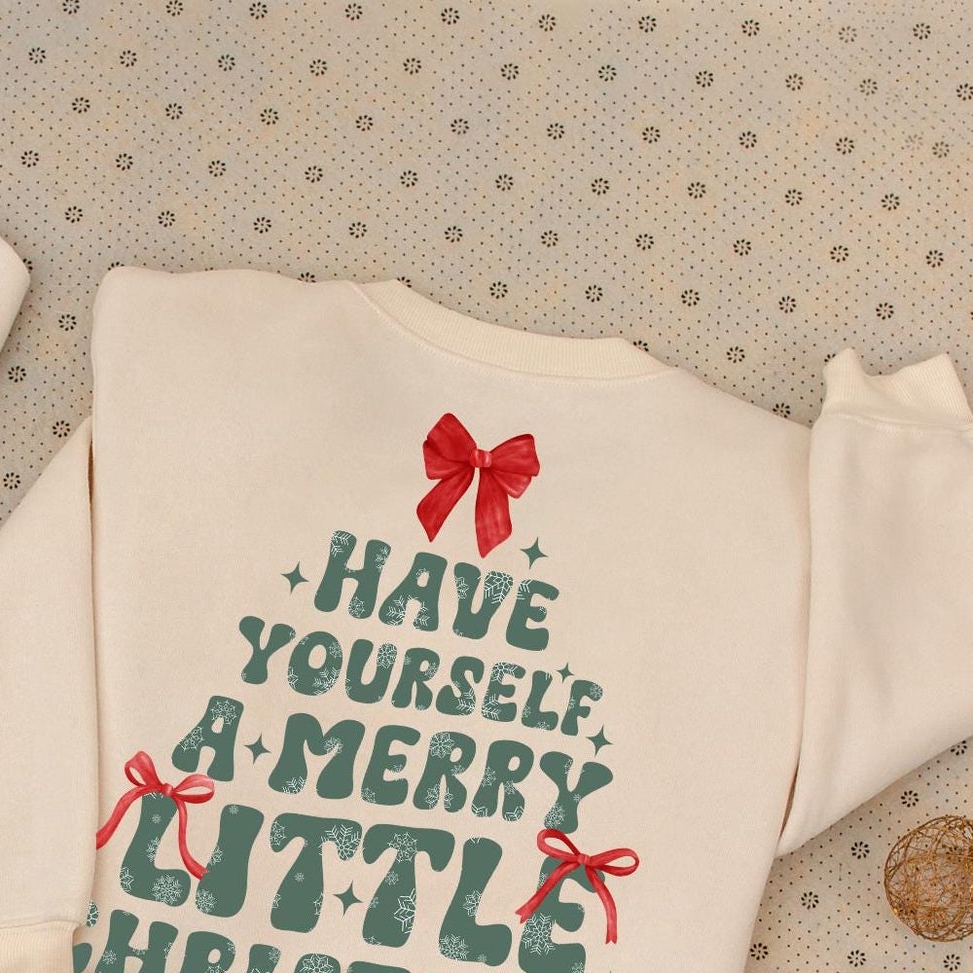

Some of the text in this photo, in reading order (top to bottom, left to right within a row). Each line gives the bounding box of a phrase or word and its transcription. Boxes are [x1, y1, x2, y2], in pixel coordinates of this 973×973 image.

[314, 530, 559, 651] HAVE
[238, 616, 603, 736] YOURSELF
[171, 695, 613, 834] A MERRY
